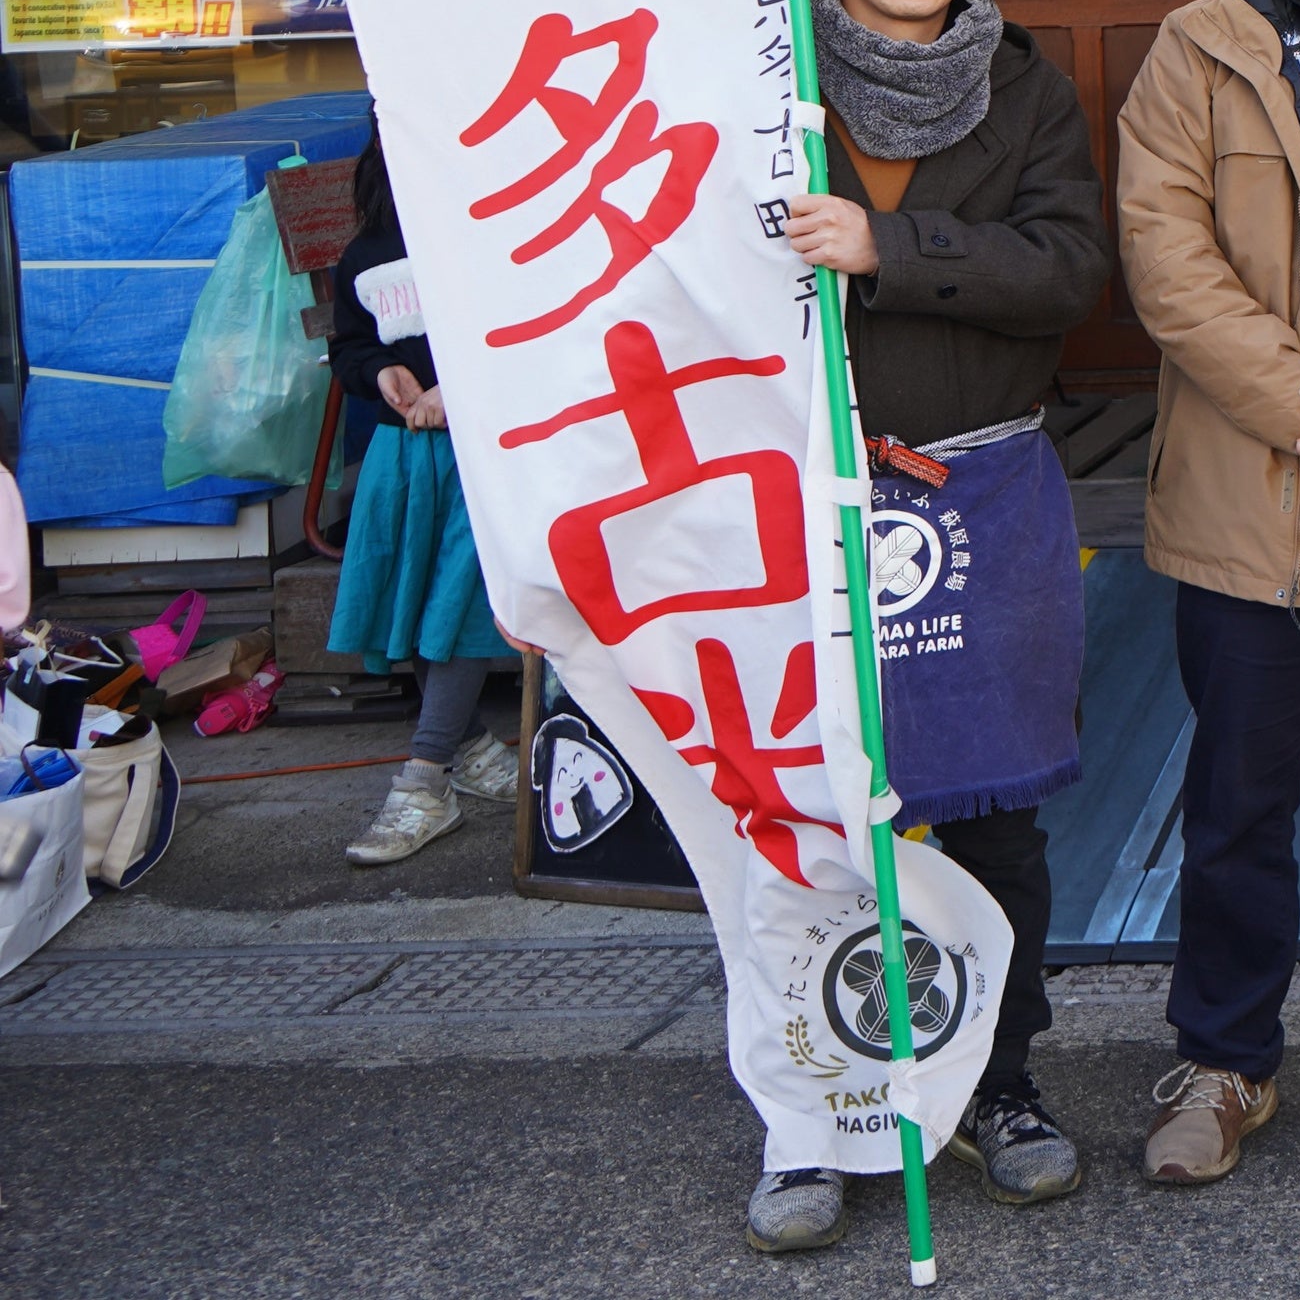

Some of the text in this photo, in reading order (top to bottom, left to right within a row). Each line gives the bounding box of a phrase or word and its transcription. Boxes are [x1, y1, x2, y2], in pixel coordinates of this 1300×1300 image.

[459, 8, 846, 890] 多古米
[937, 508, 972, 592] 萩原農場
[917, 635, 964, 655] FARM
[922, 614, 962, 636] LIFE
